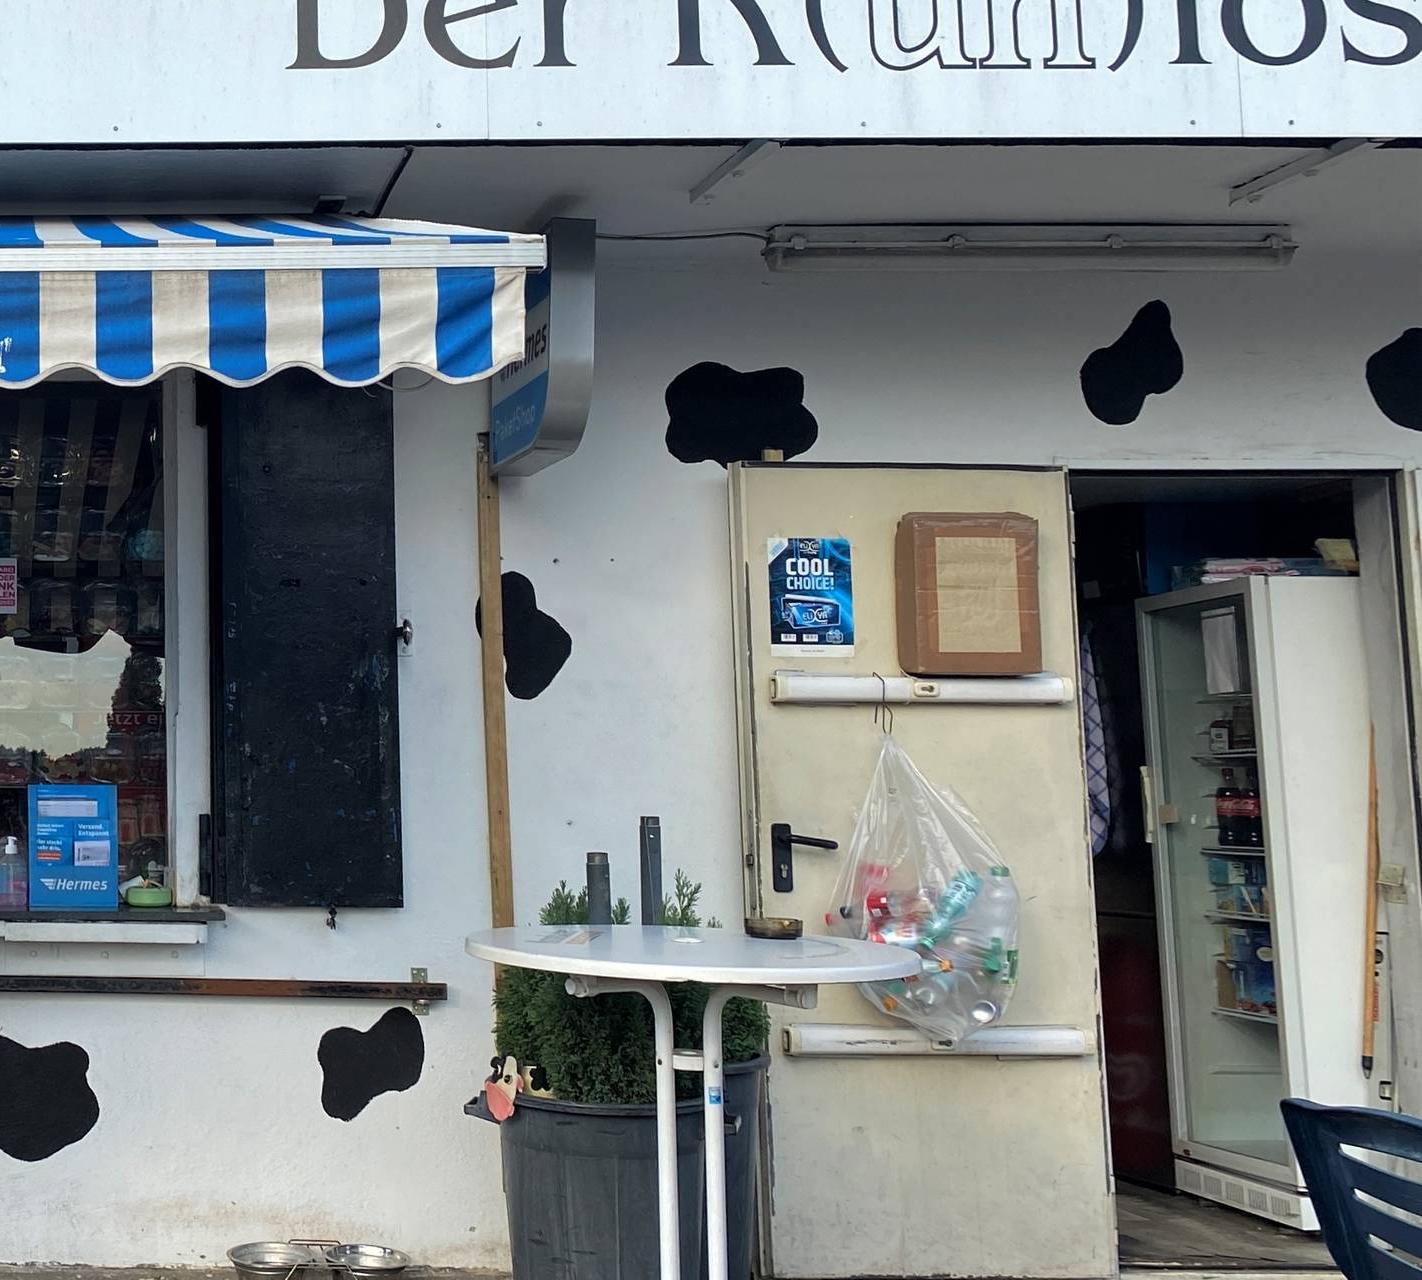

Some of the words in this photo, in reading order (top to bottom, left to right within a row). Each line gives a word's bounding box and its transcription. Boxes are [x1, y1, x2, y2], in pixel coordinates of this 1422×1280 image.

[786, 558, 834, 576] COOL
[786, 576, 835, 590] CHOICE!
[56, 878, 108, 891] Hermes
